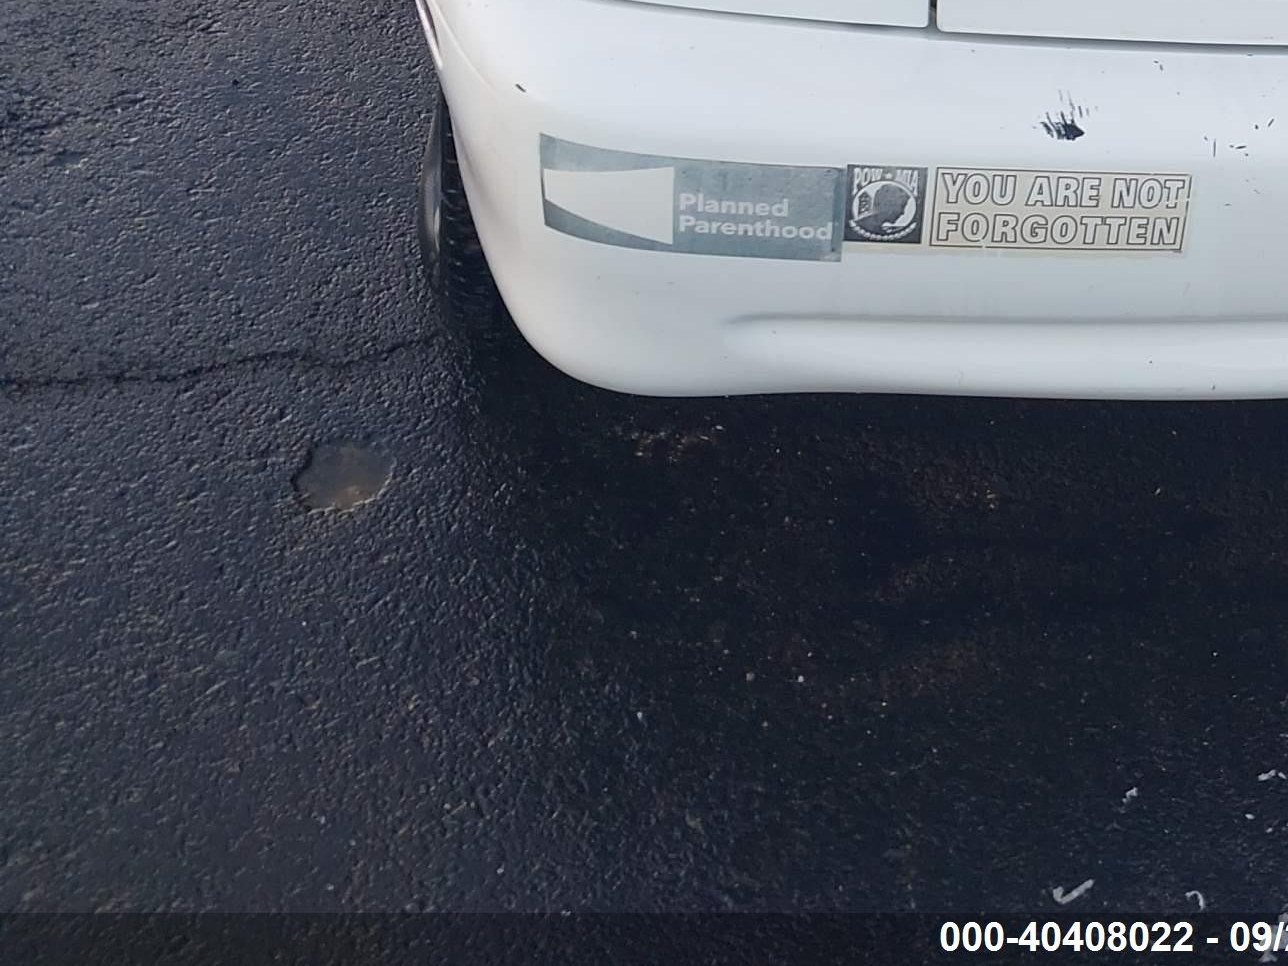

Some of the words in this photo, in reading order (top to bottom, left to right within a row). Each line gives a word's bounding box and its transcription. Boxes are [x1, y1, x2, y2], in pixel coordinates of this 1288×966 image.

[852, 167, 883, 195] POW
[942, 172, 1017, 206] YOU
[1025, 175, 1101, 208] ARE
[1111, 177, 1186, 210] NOT
[678, 193, 789, 218] Planned
[678, 214, 833, 241] Parenthood
[936, 211, 1181, 246] FORGOTTEN
